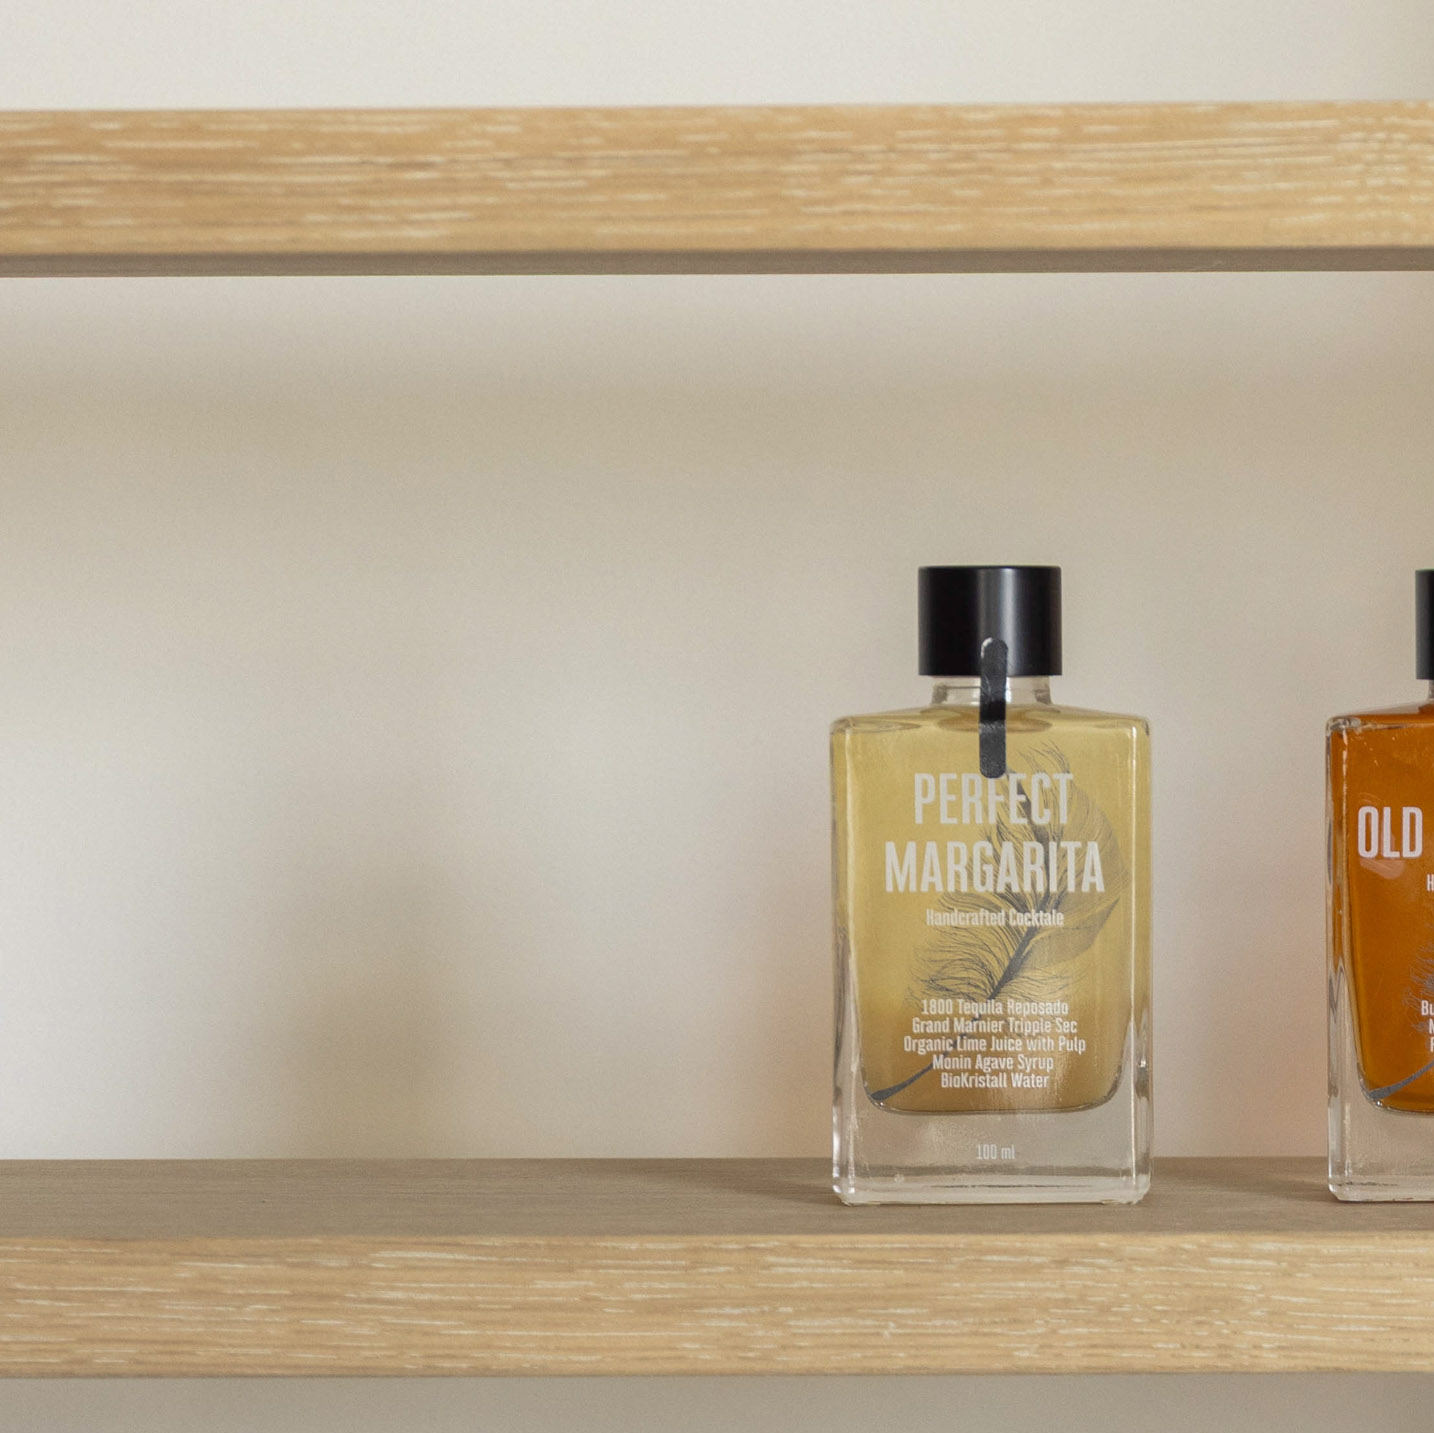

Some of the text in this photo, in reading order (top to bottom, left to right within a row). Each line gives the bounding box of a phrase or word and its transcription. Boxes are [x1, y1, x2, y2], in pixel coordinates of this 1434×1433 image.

[913, 773, 1074, 825] PERFECT
[1357, 806, 1423, 859] OLD
[884, 840, 1105, 893] MARGARITA
[926, 908, 1064, 926] Handcrafted Cocktale
[921, 1000, 1069, 1019] 1800 Tequila Reposado
[912, 1017, 1077, 1036] Grand Marnier Tripple Sec
[903, 1036, 1086, 1055] Organic Lime Juice with Pulp
[932, 1053, 1054, 1073] Monin Agave Syrup
[941, 1073, 1050, 1088] BioKristall Water
[976, 1144, 1016, 1160] 100 ml
